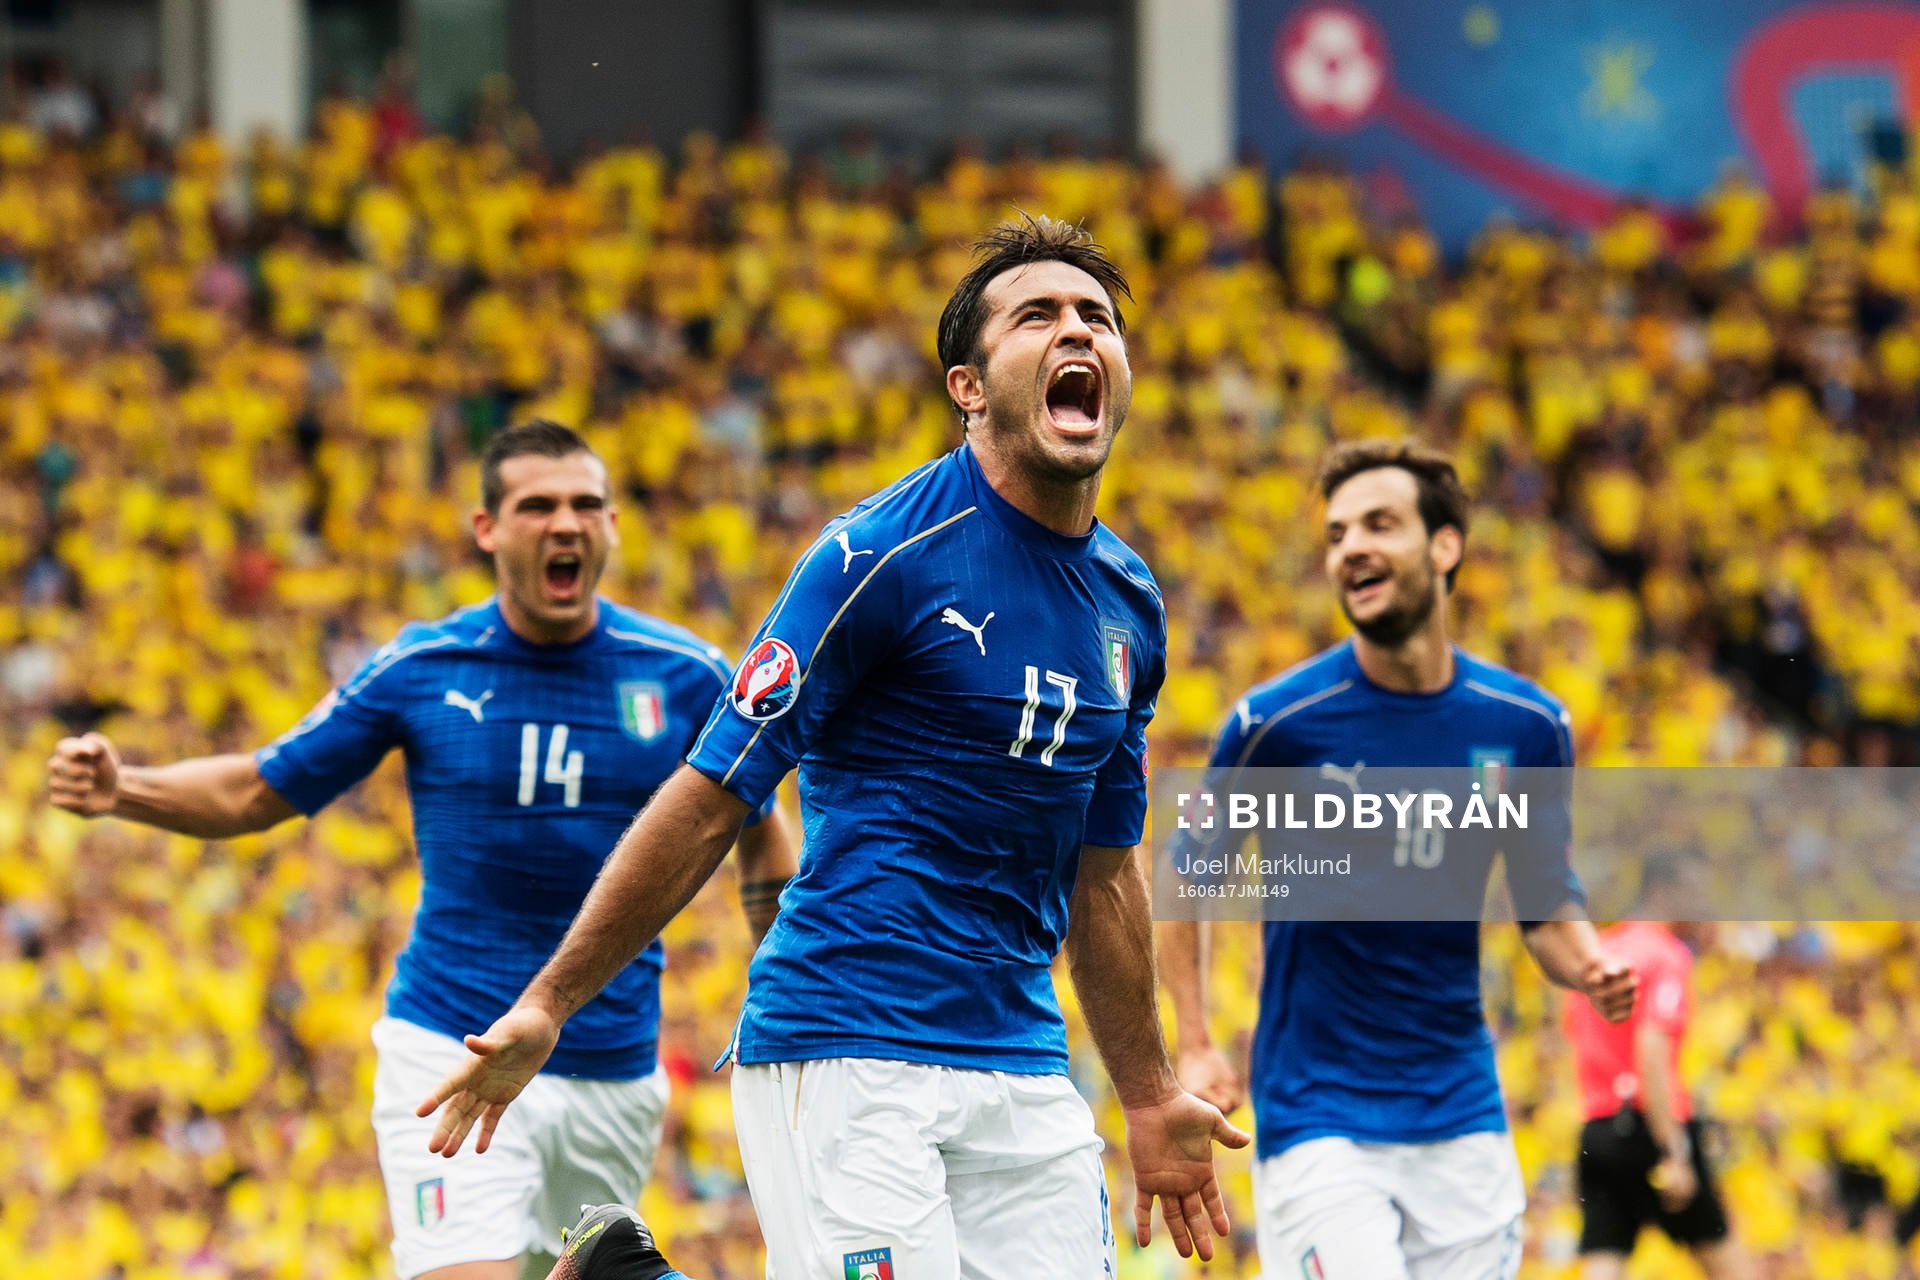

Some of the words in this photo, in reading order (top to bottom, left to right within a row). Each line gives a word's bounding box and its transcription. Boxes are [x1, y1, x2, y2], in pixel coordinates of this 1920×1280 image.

[1008, 665, 1078, 767] 17
[517, 722, 585, 808] 14
[848, 1251, 886, 1265] ITALIA
